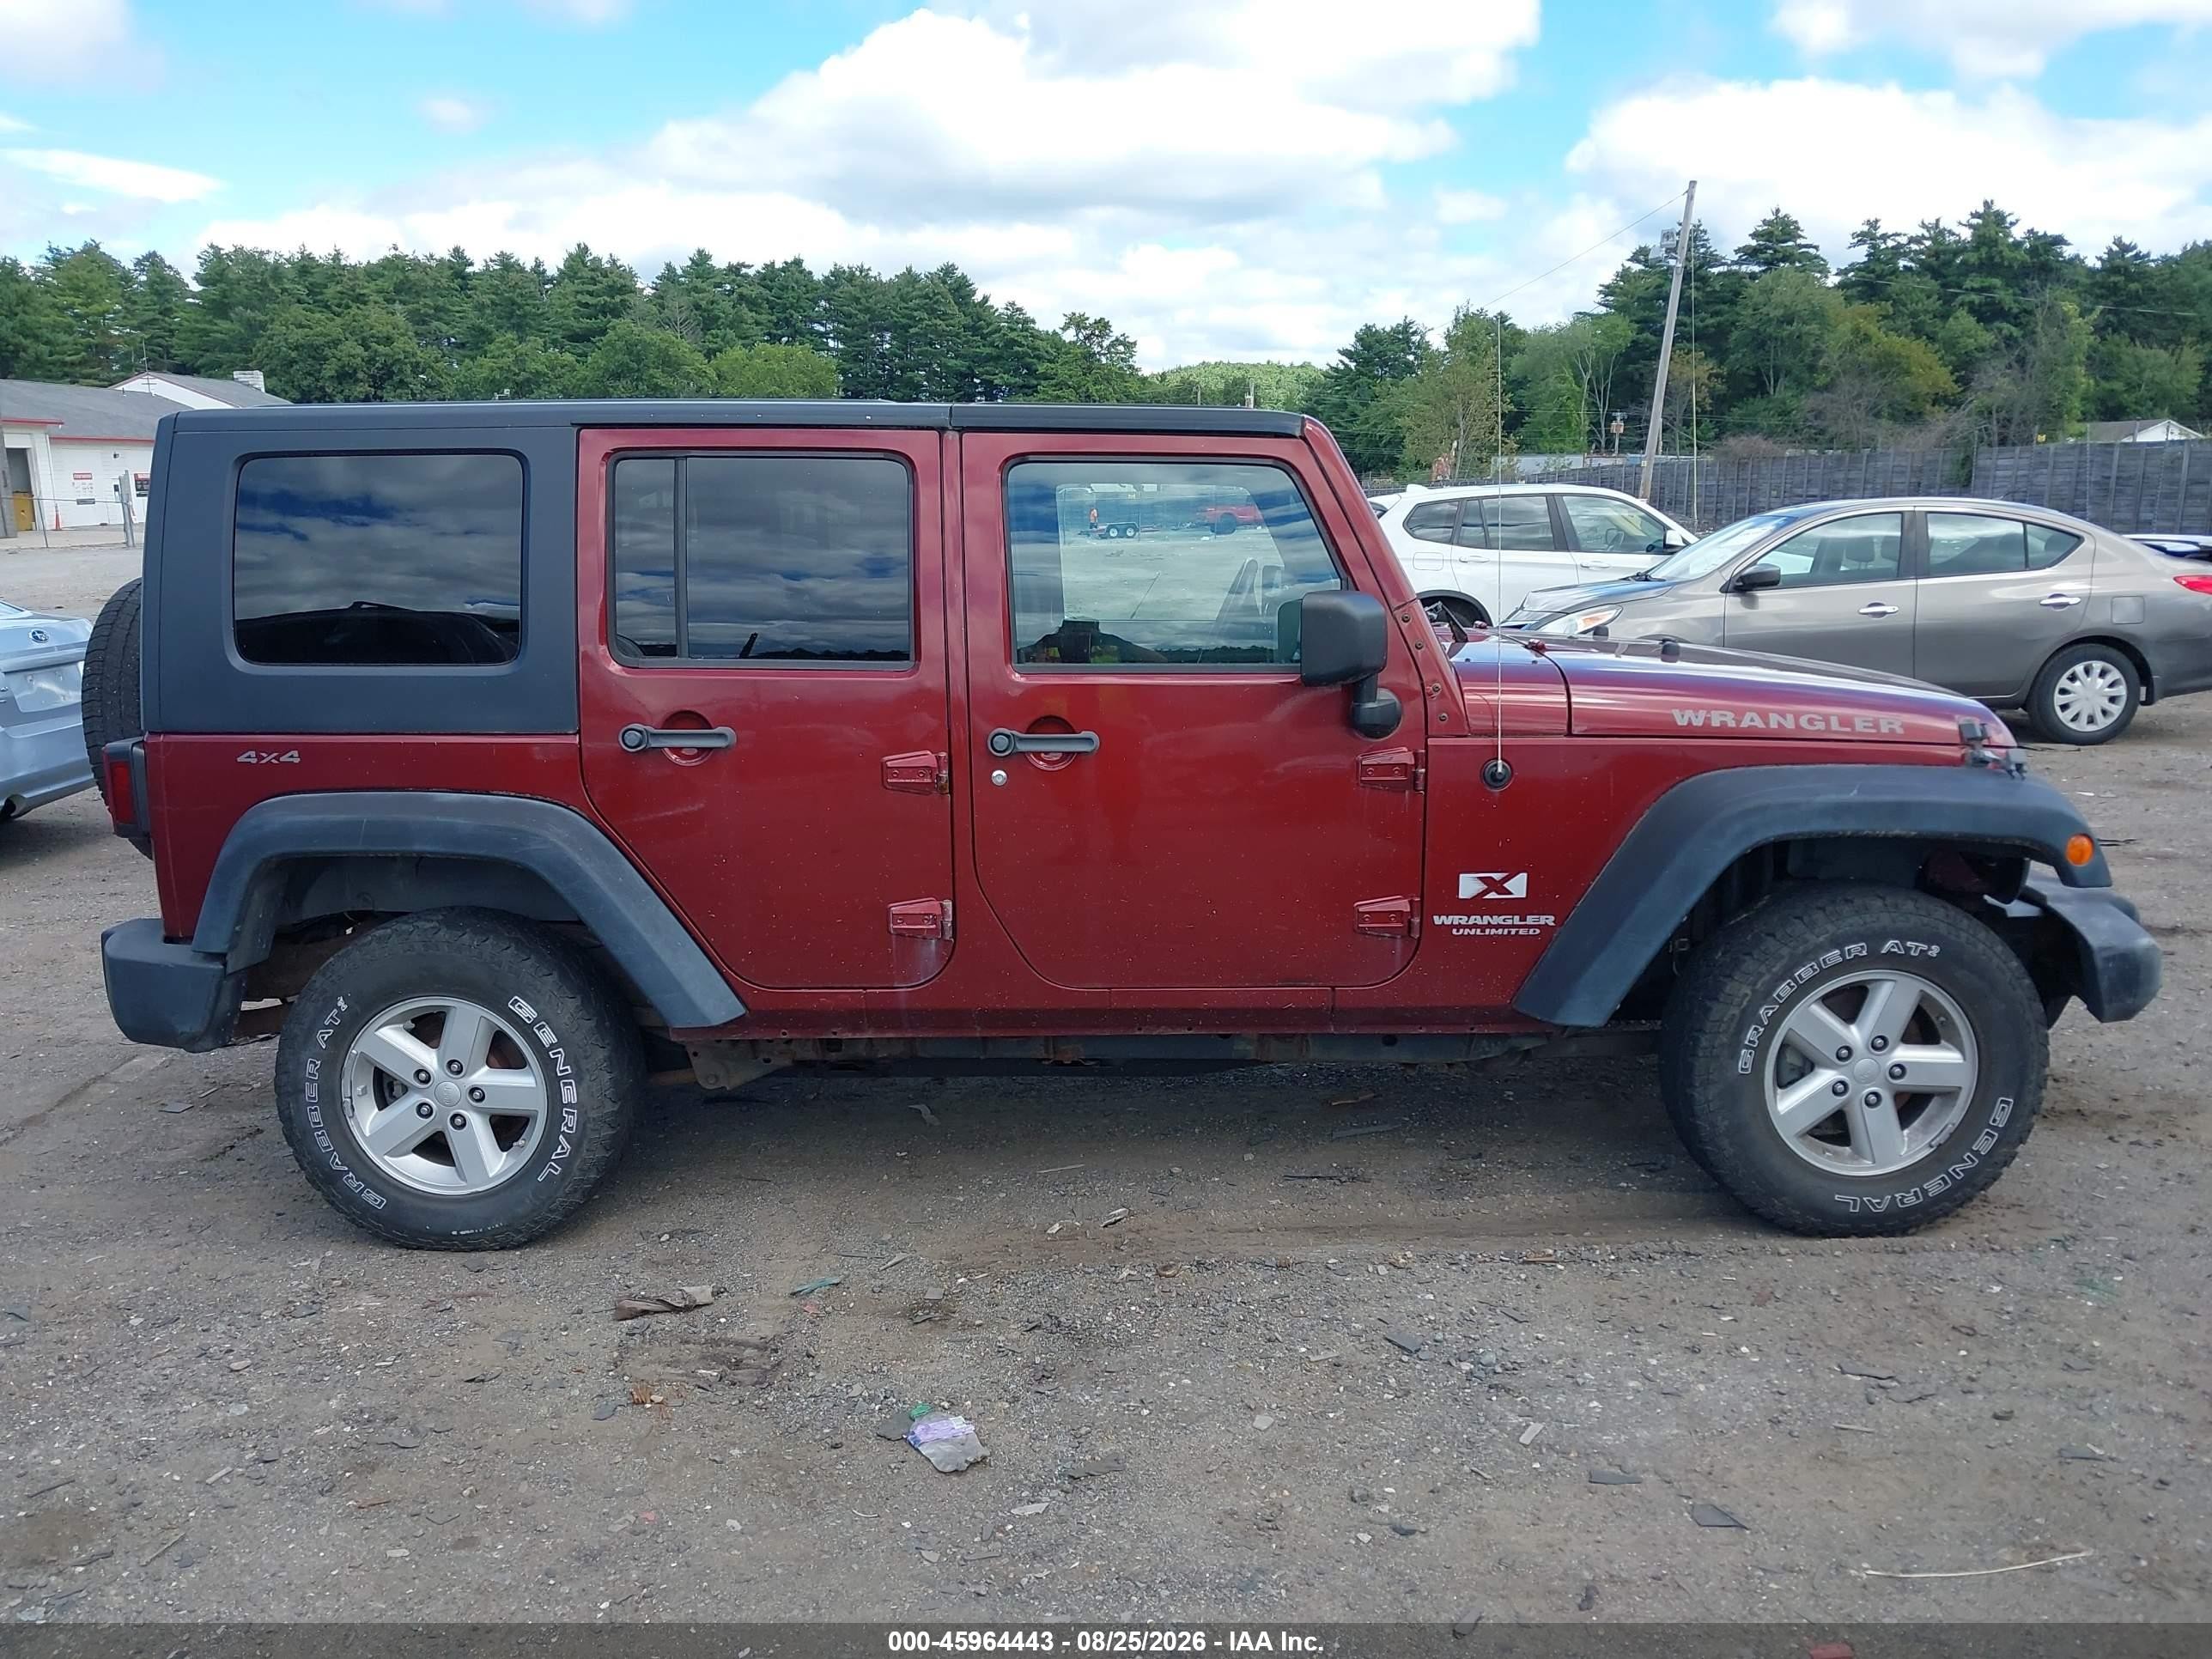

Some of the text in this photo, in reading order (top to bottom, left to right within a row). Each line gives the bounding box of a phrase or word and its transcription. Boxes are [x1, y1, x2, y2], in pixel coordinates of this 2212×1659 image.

[1671, 708, 1905, 735] WRANGLER
[1432, 915, 1556, 927] WRANGLER
[1451, 927, 1541, 936] UNLIMITED
[1738, 942, 1869, 1074] GRABBER
[304, 1057, 386, 1210] GRABBER
[507, 995, 579, 1182] GENERAL
[1834, 1097, 2014, 1214] GENERAL
